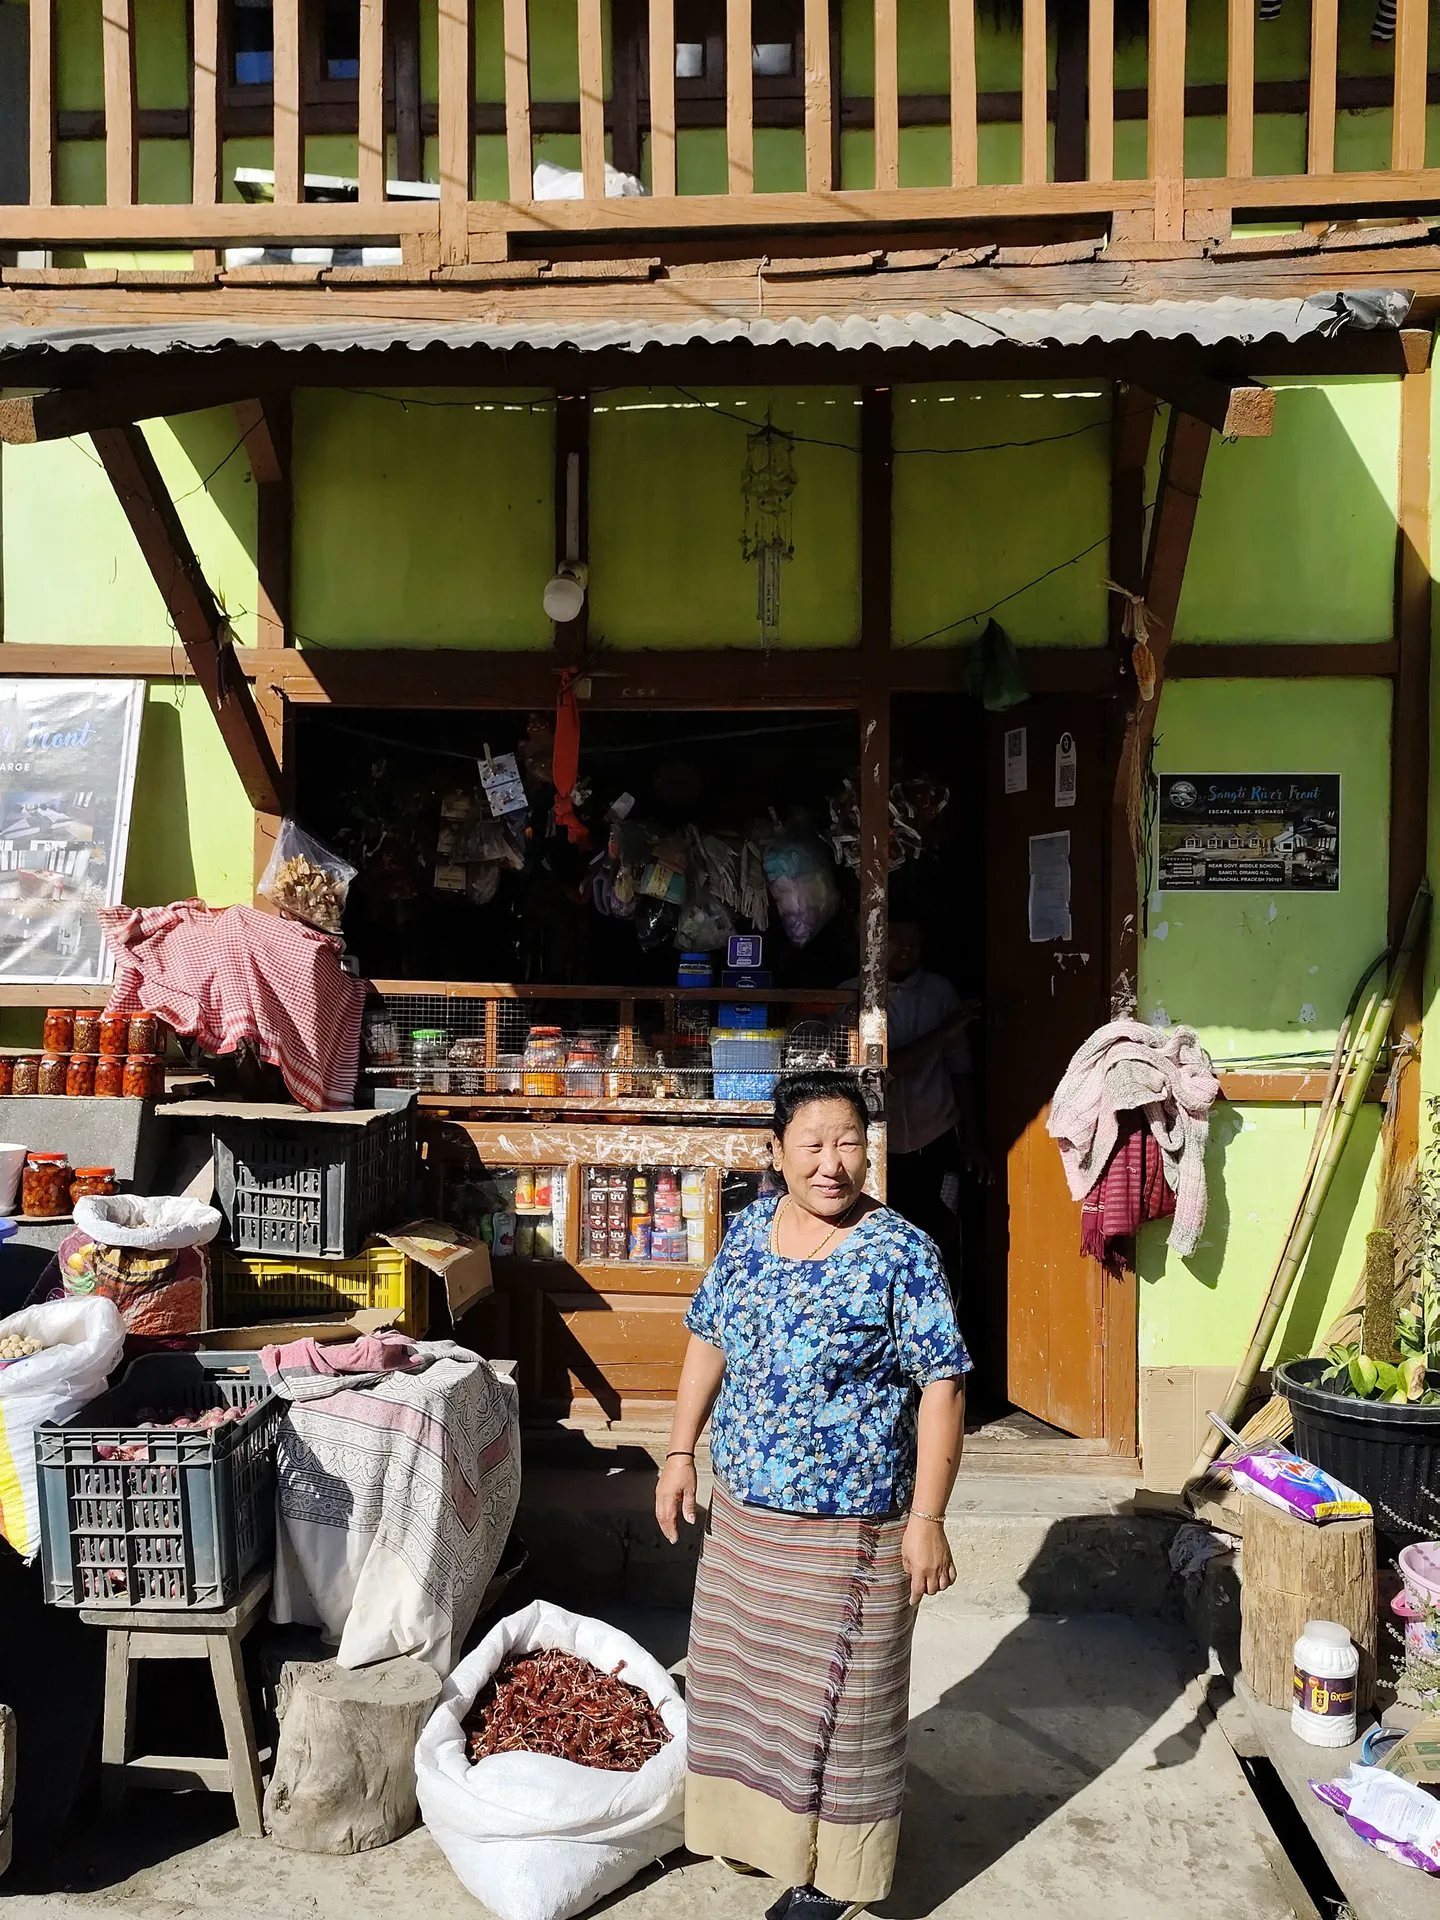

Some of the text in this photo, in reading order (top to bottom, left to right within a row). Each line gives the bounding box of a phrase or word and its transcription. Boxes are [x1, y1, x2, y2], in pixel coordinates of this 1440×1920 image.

[26, 716, 96, 750] Front
[1207, 784, 1321, 804] Sangti River Front
